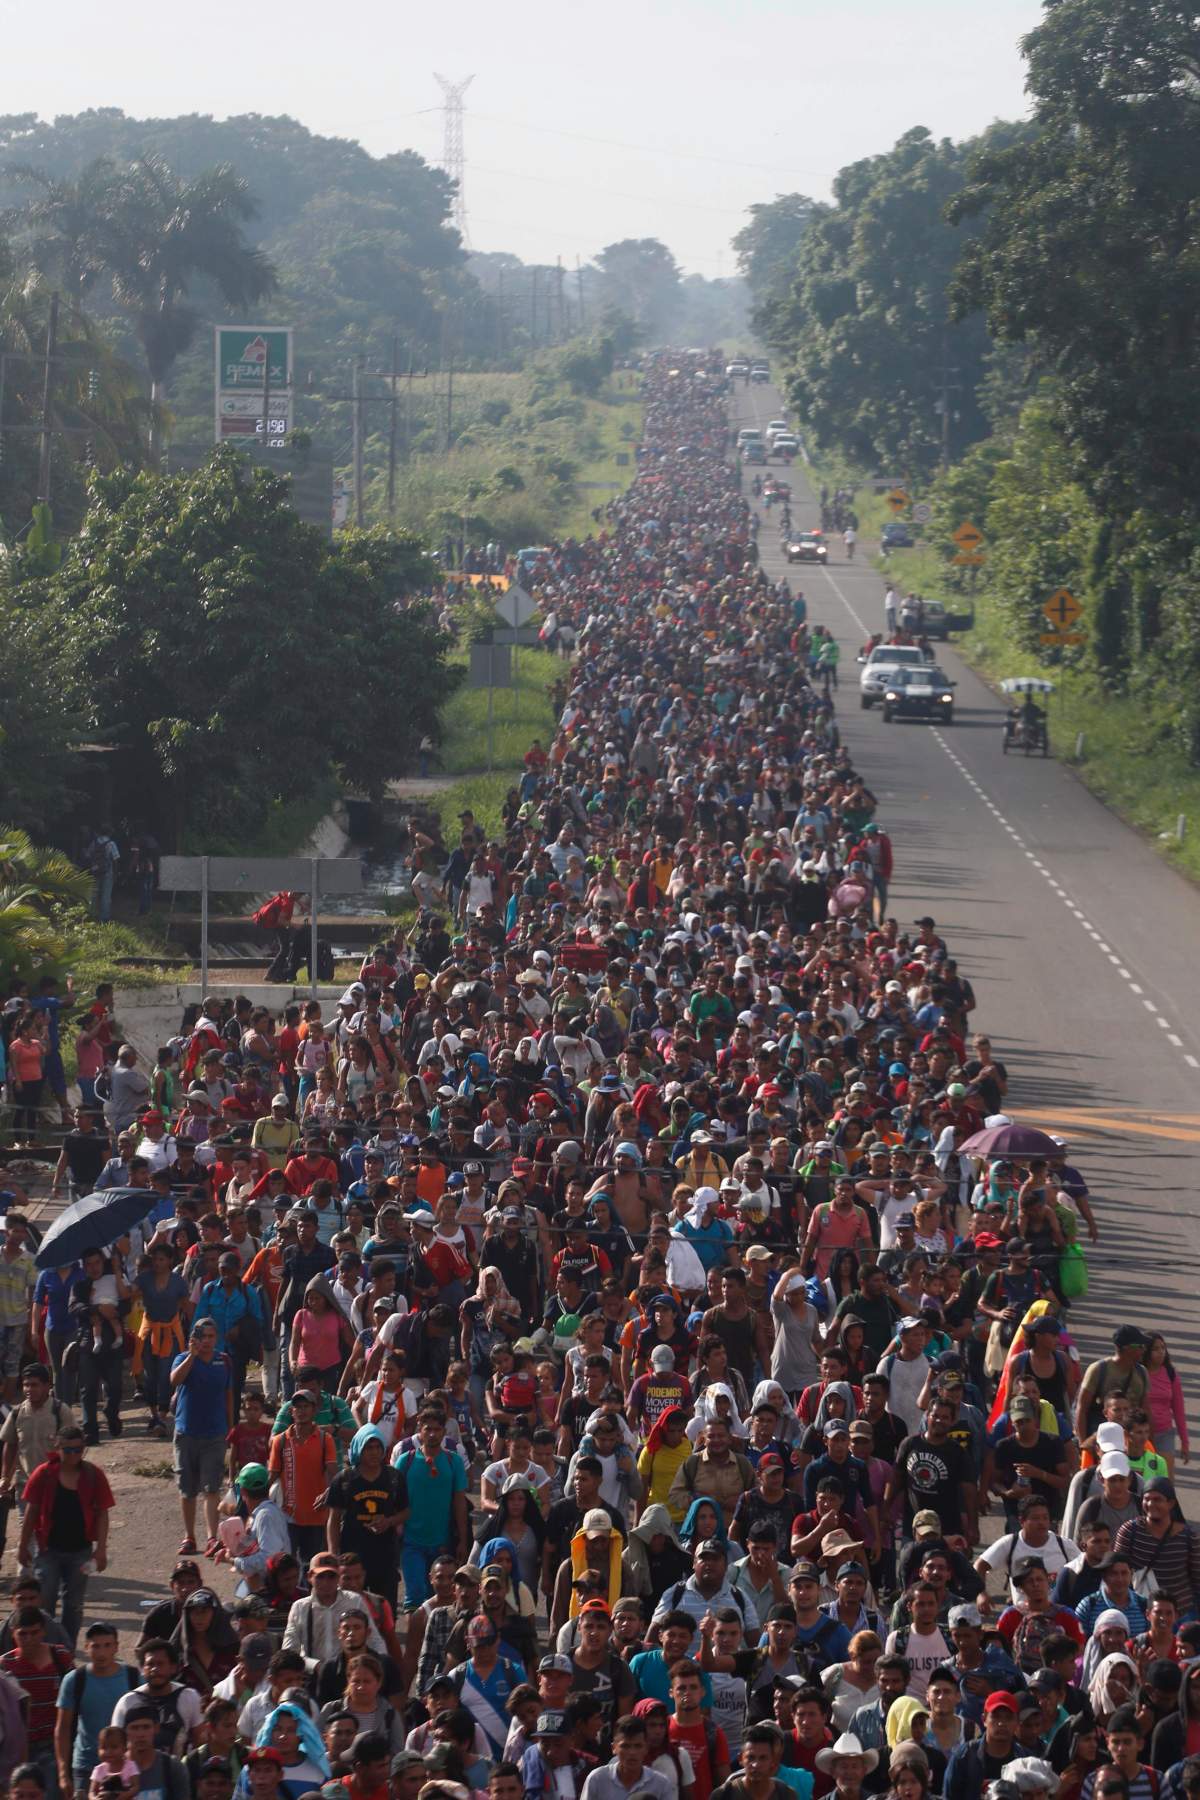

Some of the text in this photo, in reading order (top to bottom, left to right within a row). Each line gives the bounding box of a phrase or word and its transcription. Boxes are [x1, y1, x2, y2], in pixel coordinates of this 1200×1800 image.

[226, 364, 283, 377] PEMX
[646, 1386, 682, 1398] PODEMOS
[645, 1398, 675, 1407] MOVER
